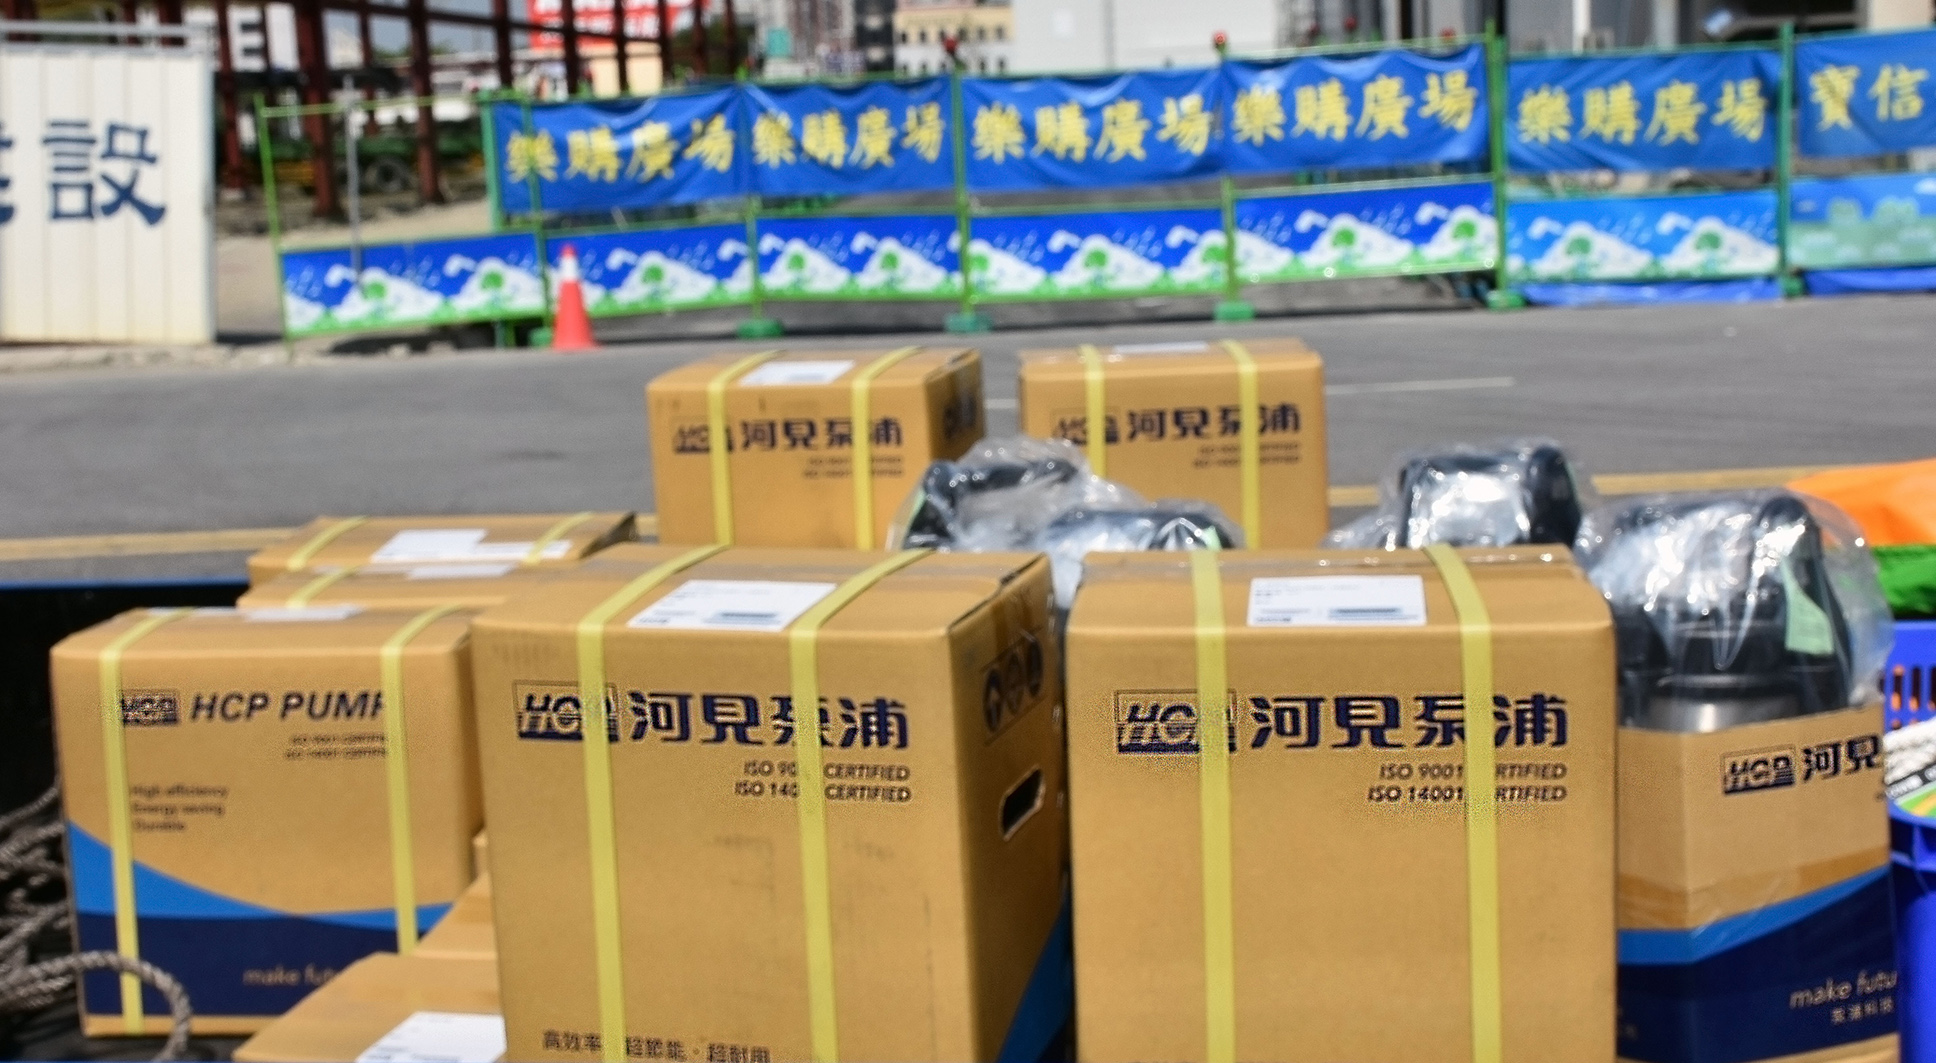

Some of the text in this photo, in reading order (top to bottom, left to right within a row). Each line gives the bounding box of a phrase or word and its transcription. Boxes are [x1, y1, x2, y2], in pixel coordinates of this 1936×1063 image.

[972, 91, 1215, 163] 樂購廣場
[1233, 68, 1480, 146] 樂購廣場
[1517, 77, 1768, 146] 樂購廣場
[506, 113, 736, 183] 樂購廣場
[752, 101, 945, 168] 樂購廣場
[0, 119, 165, 226] 設
[741, 417, 903, 452] 河見泵浦
[1127, 403, 1300, 442] 河見泵浦
[190, 691, 271, 722] HCP
[628, 690, 909, 751] 河見泵浦
[1248, 693, 1568, 750] 河見泵浦
[744, 759, 775, 778] ISO
[823, 762, 911, 782] CERTIFIED
[1379, 762, 1568, 781] ISO 9001 RTIFIED
[1801, 734, 1882, 783] 河見
[734, 779, 765, 798] ISO
[824, 783, 912, 803] CERTIFIED
[1367, 784, 1568, 803] ISO 14001 RTIFIED
[1788, 977, 1852, 1010] make
